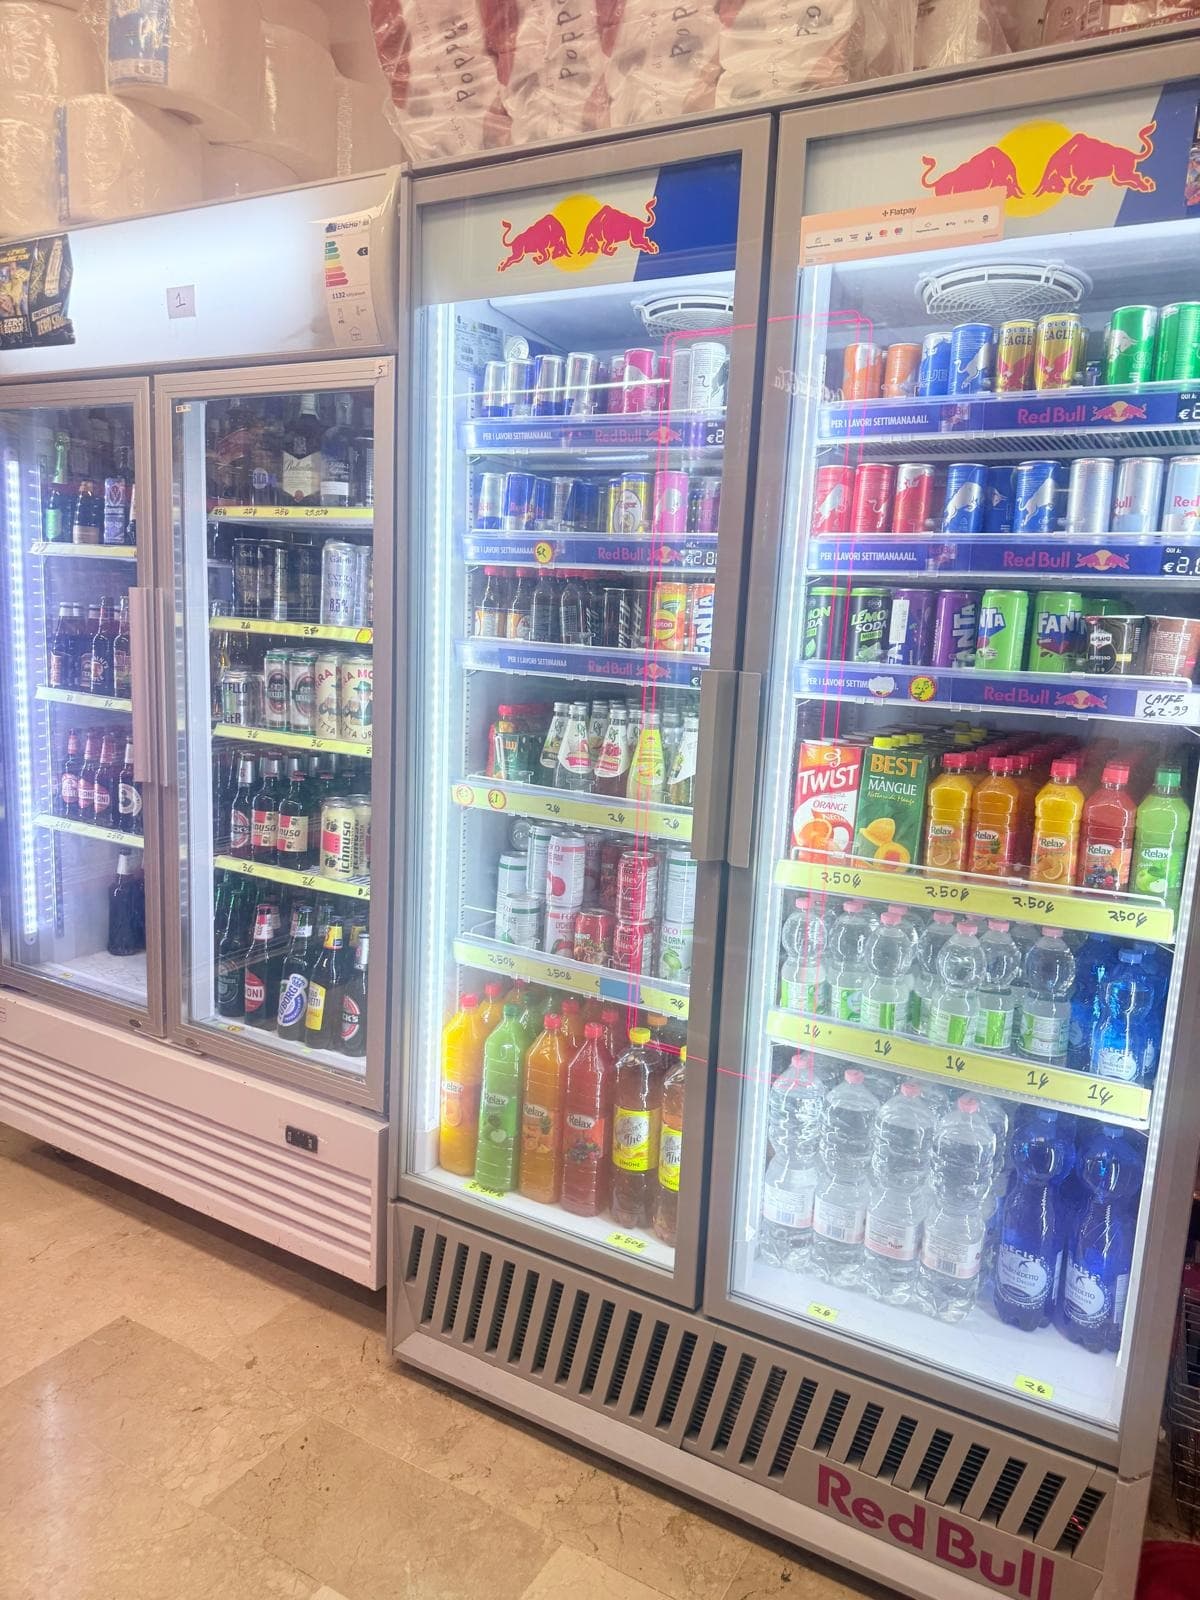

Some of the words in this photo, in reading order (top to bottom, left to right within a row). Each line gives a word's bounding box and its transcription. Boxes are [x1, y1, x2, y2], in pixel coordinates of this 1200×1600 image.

[556, 0, 584, 80] Popp
[889, 206, 917, 217] Flatpay
[175, 291, 187, 309] 1
[332, 291, 346, 300] 1132
[1004, 334, 1033, 346] EAGLE
[1044, 329, 1074, 341] EAGLE
[377, 364, 386, 374] 5
[1017, 406, 1051, 424] Red
[1053, 404, 1086, 422] Bull
[831, 418, 844, 428] PER
[848, 417, 873, 428] LAVORI
[595, 429, 618, 443] Red
[620, 428, 641, 442] Bull
[598, 547, 620, 560] Red
[621, 547, 643, 561] Bull
[686, 550, 718, 566] €2.0
[820, 551, 832, 561] PER
[838, 551, 861, 561] LAVORI
[1003, 551, 1036, 568] Red
[1038, 550, 1071, 568] Bull
[807, 606, 832, 620] ON
[851, 609, 888, 626] LEMO
[979, 607, 1005, 629] NTA
[854, 620, 887, 634] SODA
[588, 660, 610, 675] Red
[611, 662, 632, 676] Bull
[806, 677, 818, 687] PER
[822, 678, 845, 688] LAVORI
[984, 685, 1016, 702] Red
[1017, 686, 1050, 705] Bull
[870, 753, 923, 779] BEST
[798, 763, 859, 796] TWIST
[812, 799, 849, 813] ORANGE
[931, 825, 953, 836] Relax
[975, 830, 997, 841] Relax
[1040, 837, 1065, 850] Relax
[1088, 844, 1113, 856] Relax
[1144, 848, 1169, 860] Relax
[821, 871, 862, 888] 2.50€
[925, 886, 970, 902] 2.50€
[1012, 896, 1055, 914] 2.50€
[245, 986, 265, 999] ONI
[343, 1014, 359, 1024] CK'S
[803, 1023, 820, 1039] 1€
[874, 1039, 892, 1056] 1€
[945, 1055, 966, 1073] 1€
[1026, 1070, 1050, 1090] 1€
[442, 1082, 464, 1094] elax
[1087, 1084, 1114, 1106] 1€
[485, 1092, 507, 1106] Relax
[524, 1104, 546, 1118] Relax
[568, 1115, 593, 1130] Relax
[618, 1160, 642, 1169] LIMONE
[1024, 1380, 1047, 1395] 2€
[817, 1463, 927, 1551] Red
[935, 1516, 1056, 1600] Bull
